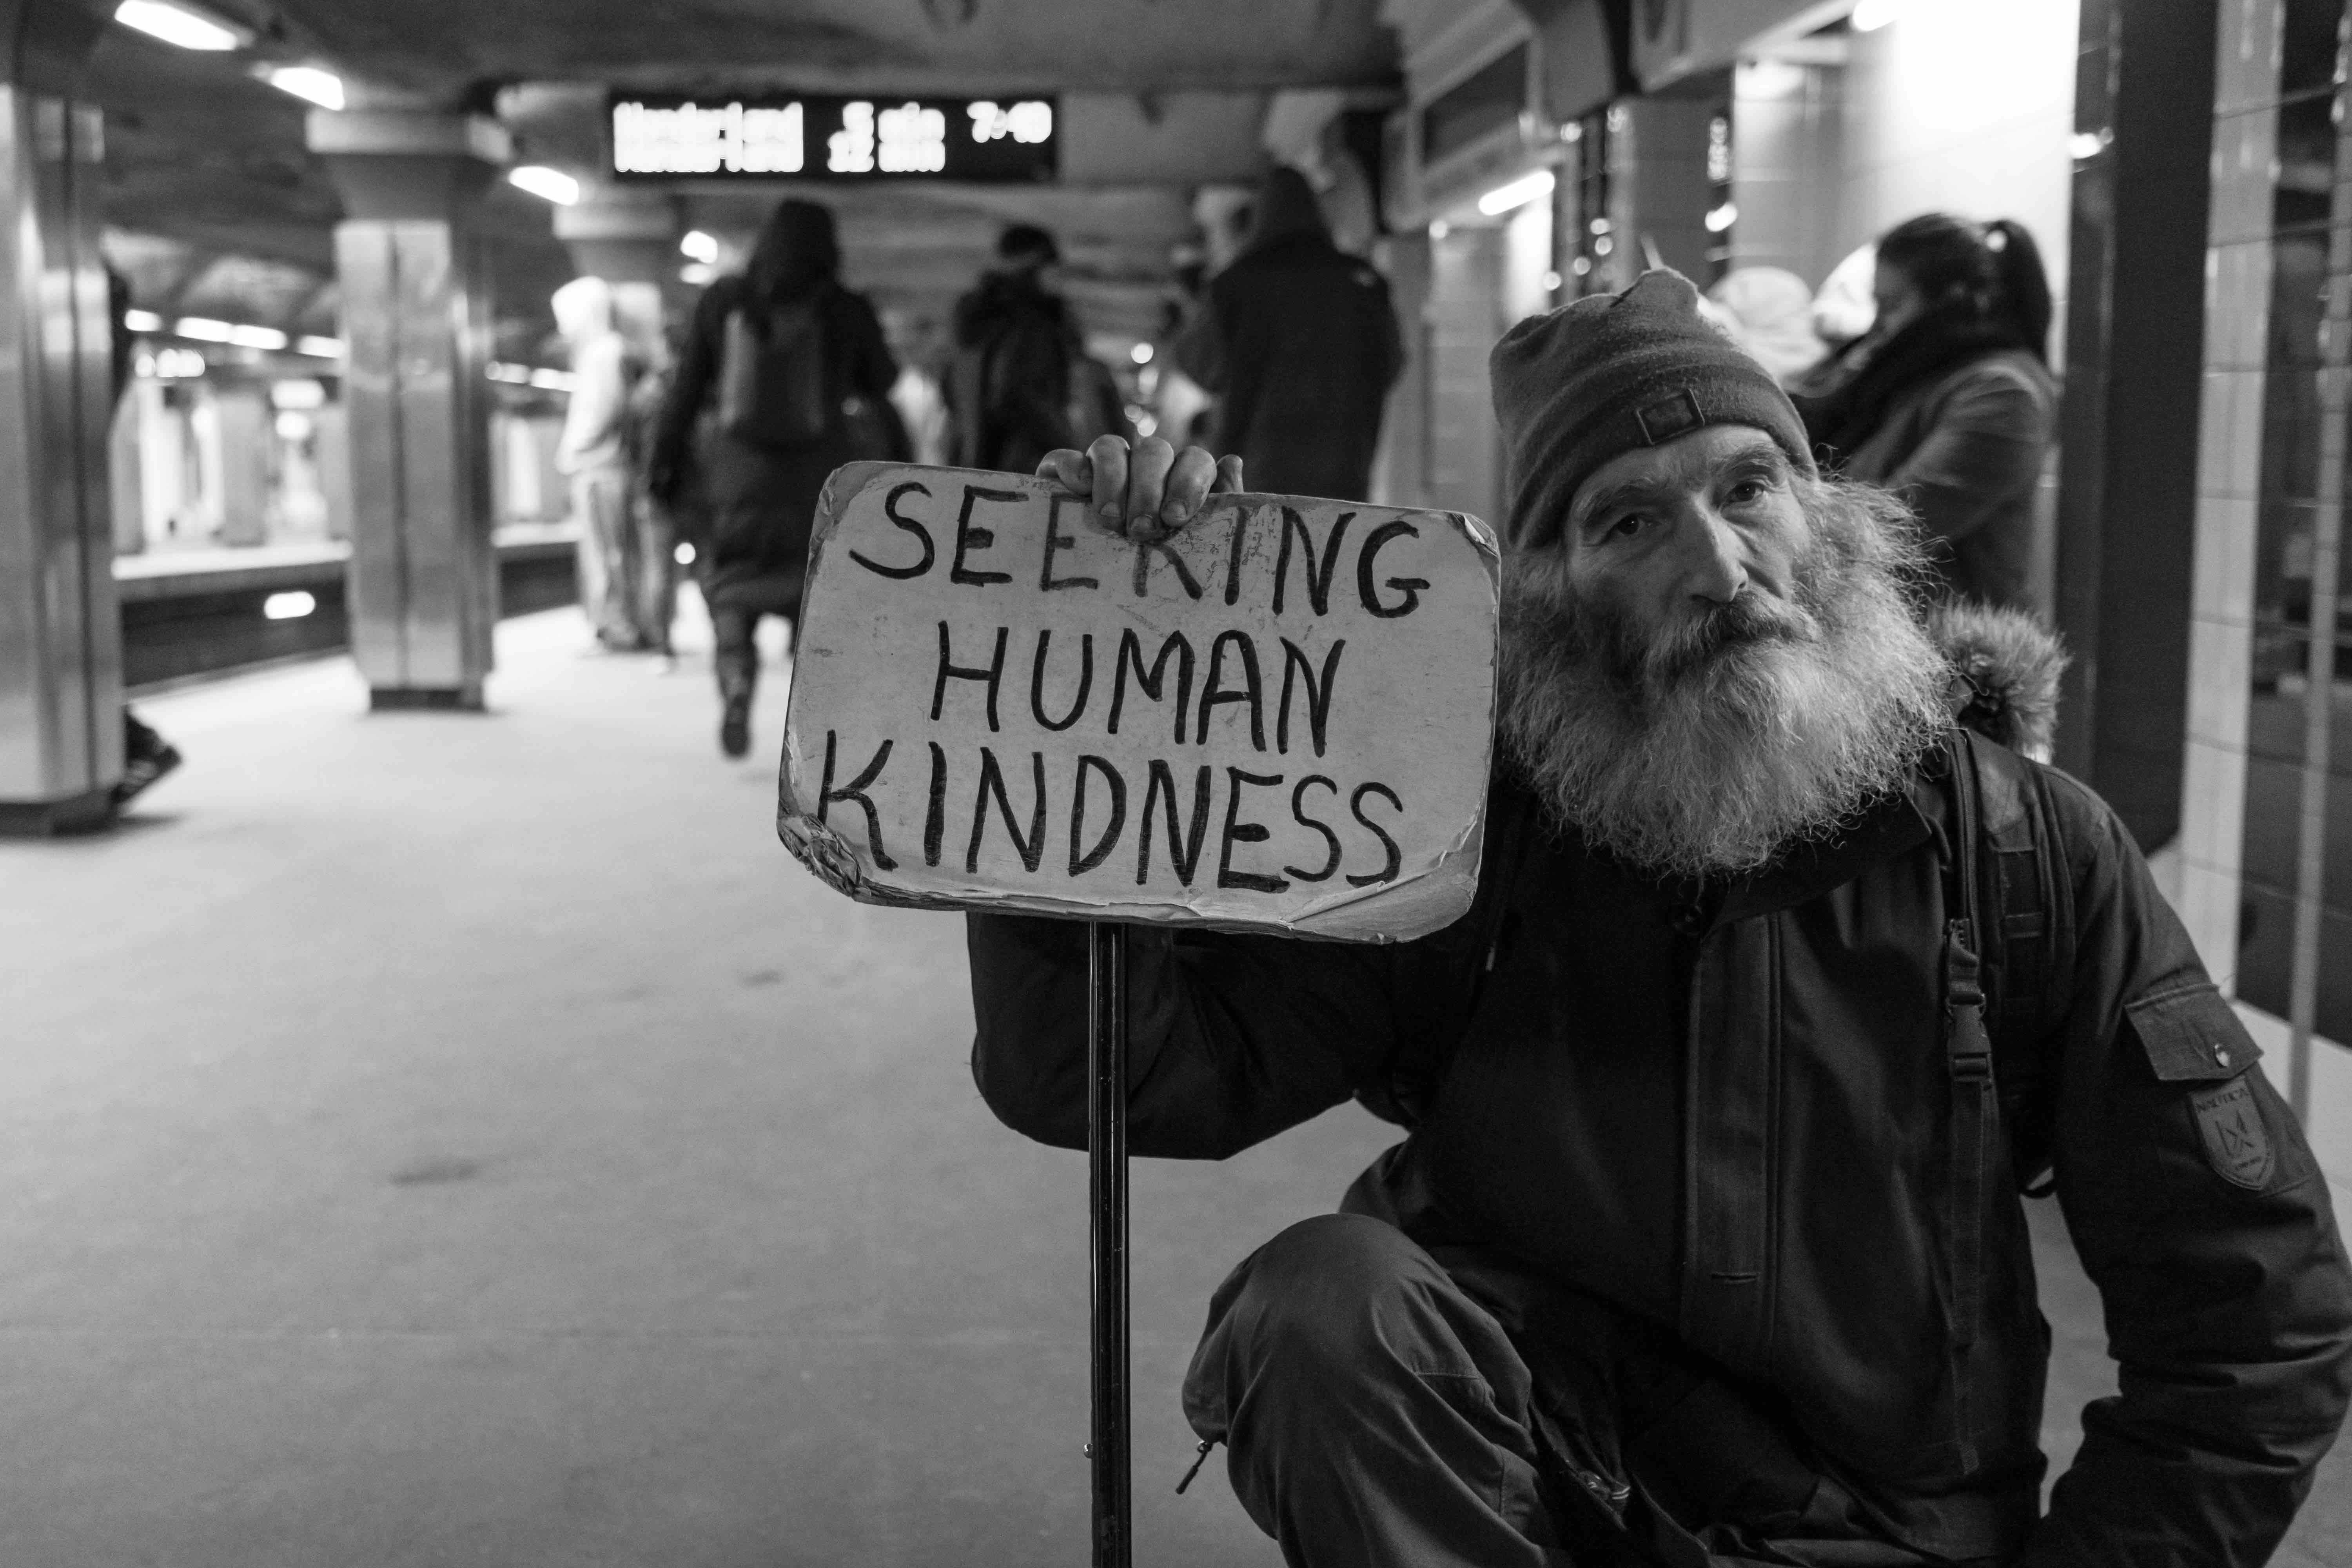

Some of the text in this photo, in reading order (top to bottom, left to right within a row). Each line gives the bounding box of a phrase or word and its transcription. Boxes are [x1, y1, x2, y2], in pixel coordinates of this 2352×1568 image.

[849, 482, 1430, 618] SEEKING
[931, 621, 1345, 757] HUMAN
[818, 730, 1403, 892] KINDNESS
